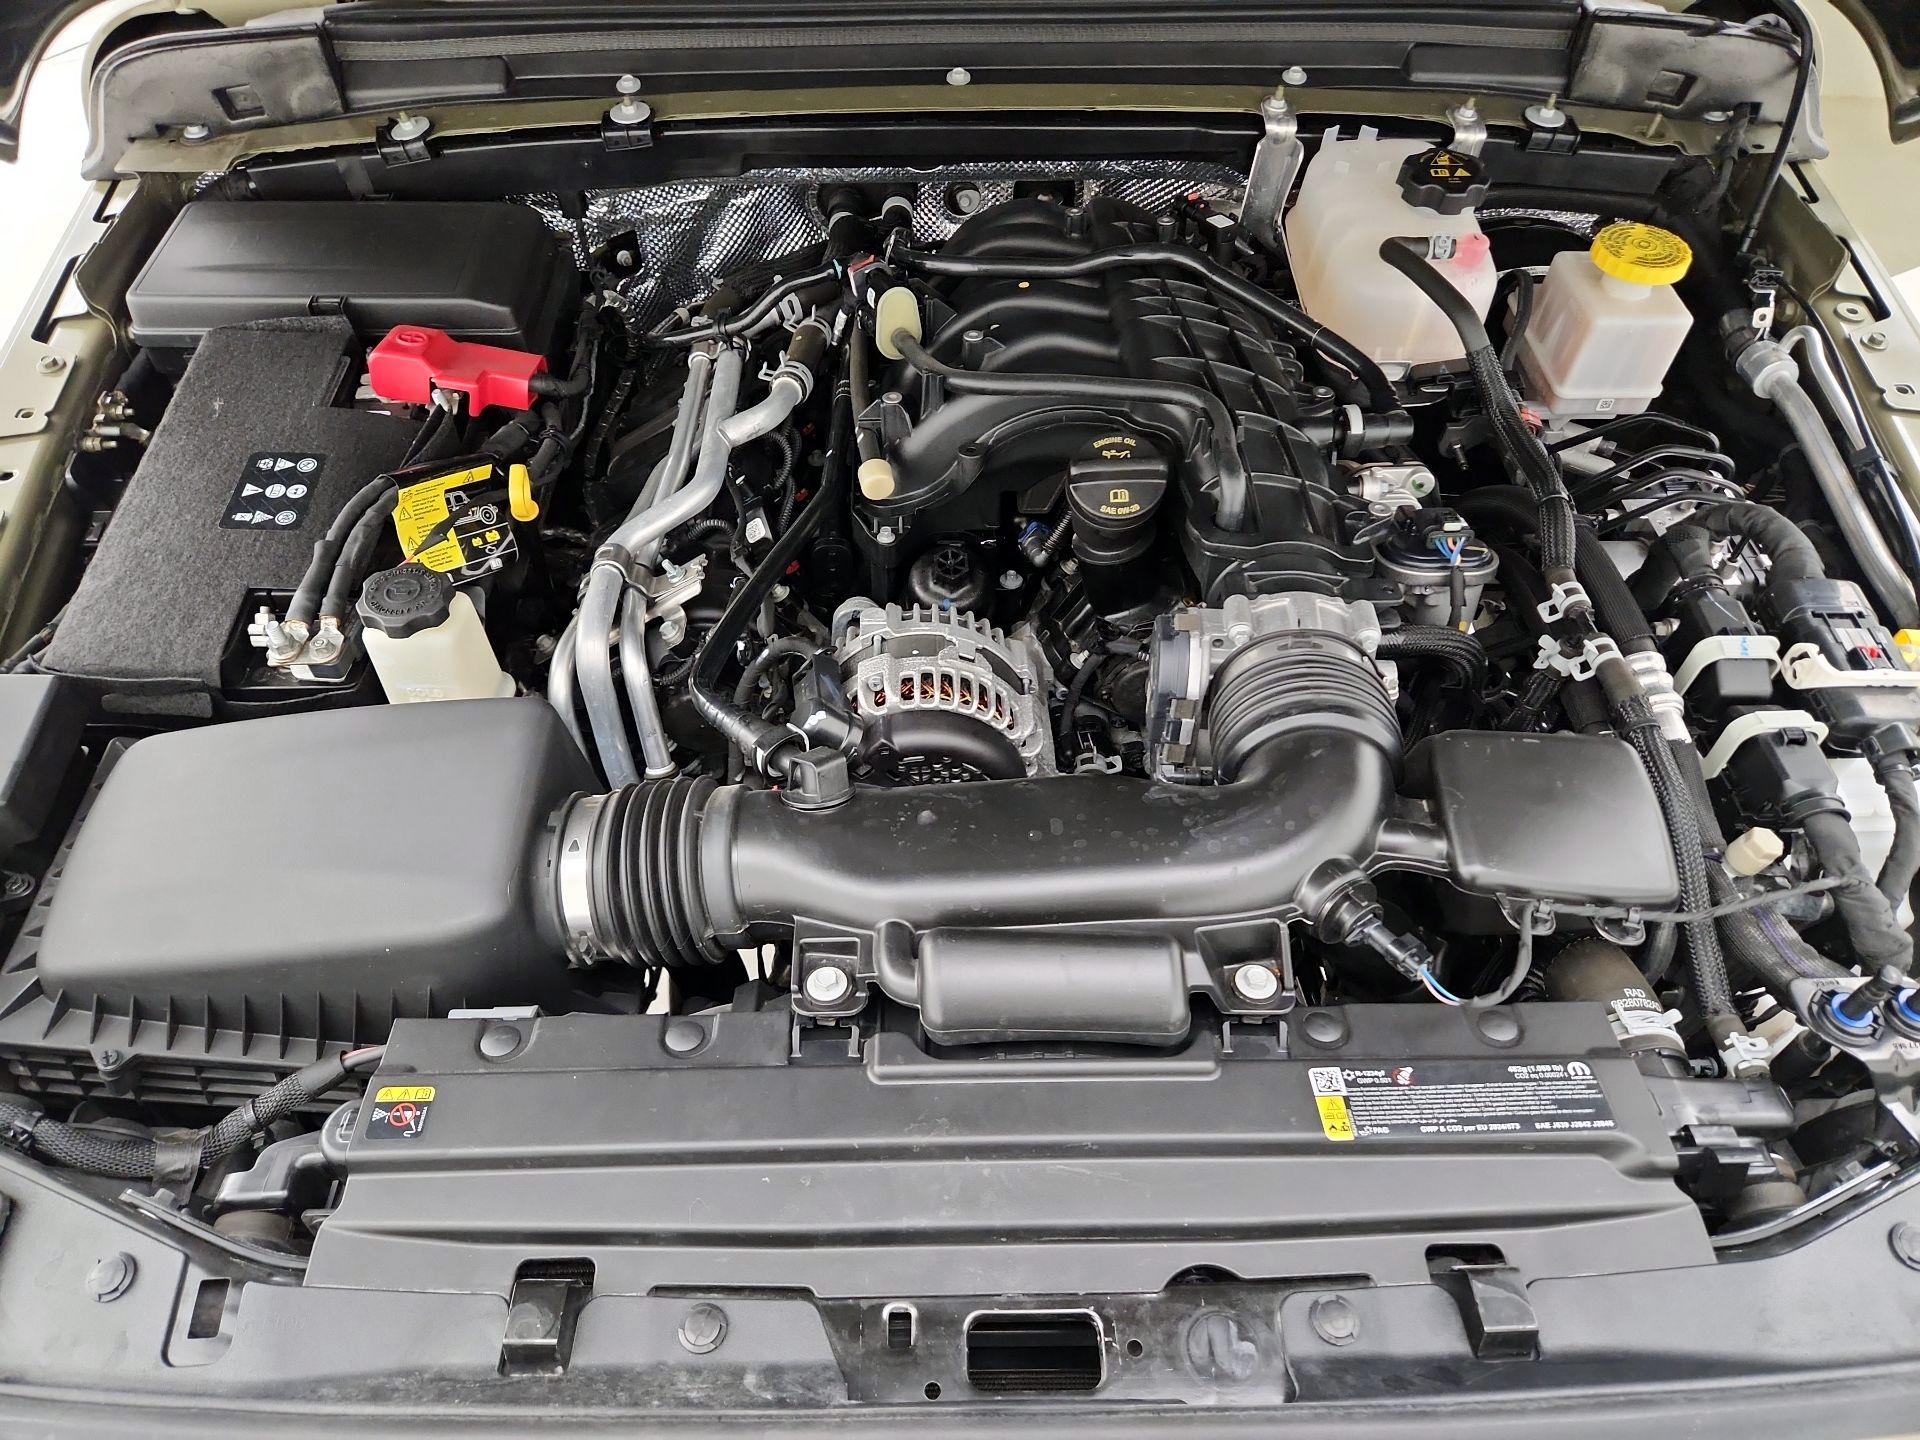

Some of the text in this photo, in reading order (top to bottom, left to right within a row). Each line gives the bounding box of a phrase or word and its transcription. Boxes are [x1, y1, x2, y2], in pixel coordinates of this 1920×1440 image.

[1093, 436, 1136, 449] ENGINE OIL
[1100, 504, 1116, 515] SAE
[1623, 988, 1646, 998] RAD
